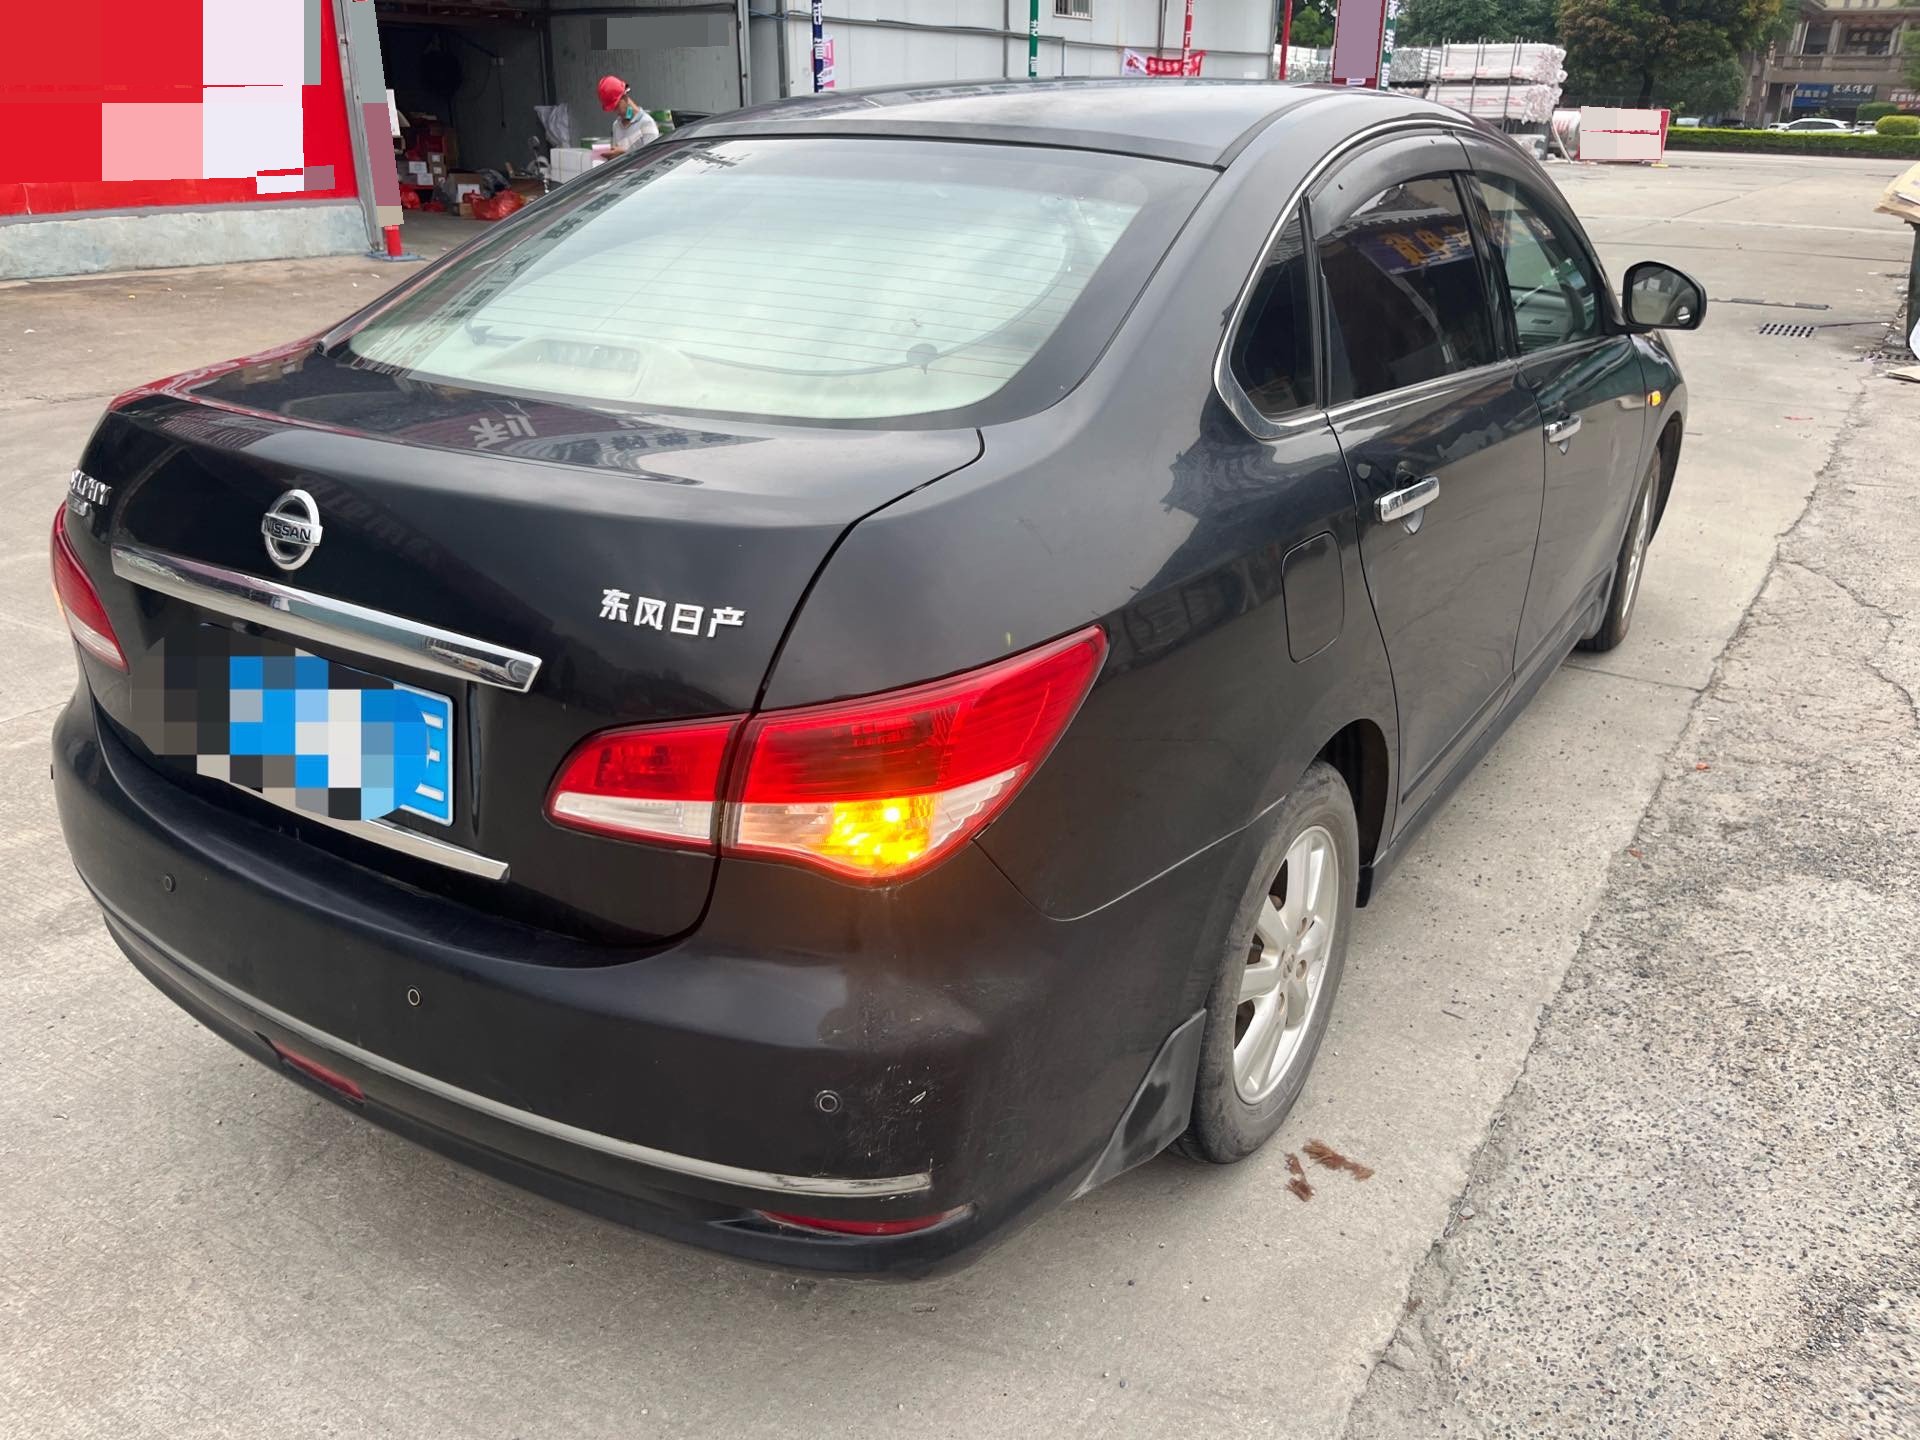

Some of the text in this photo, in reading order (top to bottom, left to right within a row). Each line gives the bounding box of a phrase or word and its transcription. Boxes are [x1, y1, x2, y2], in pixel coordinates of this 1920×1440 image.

[263, 517, 312, 542] NISSAN
[599, 588, 747, 638] 东风日产
